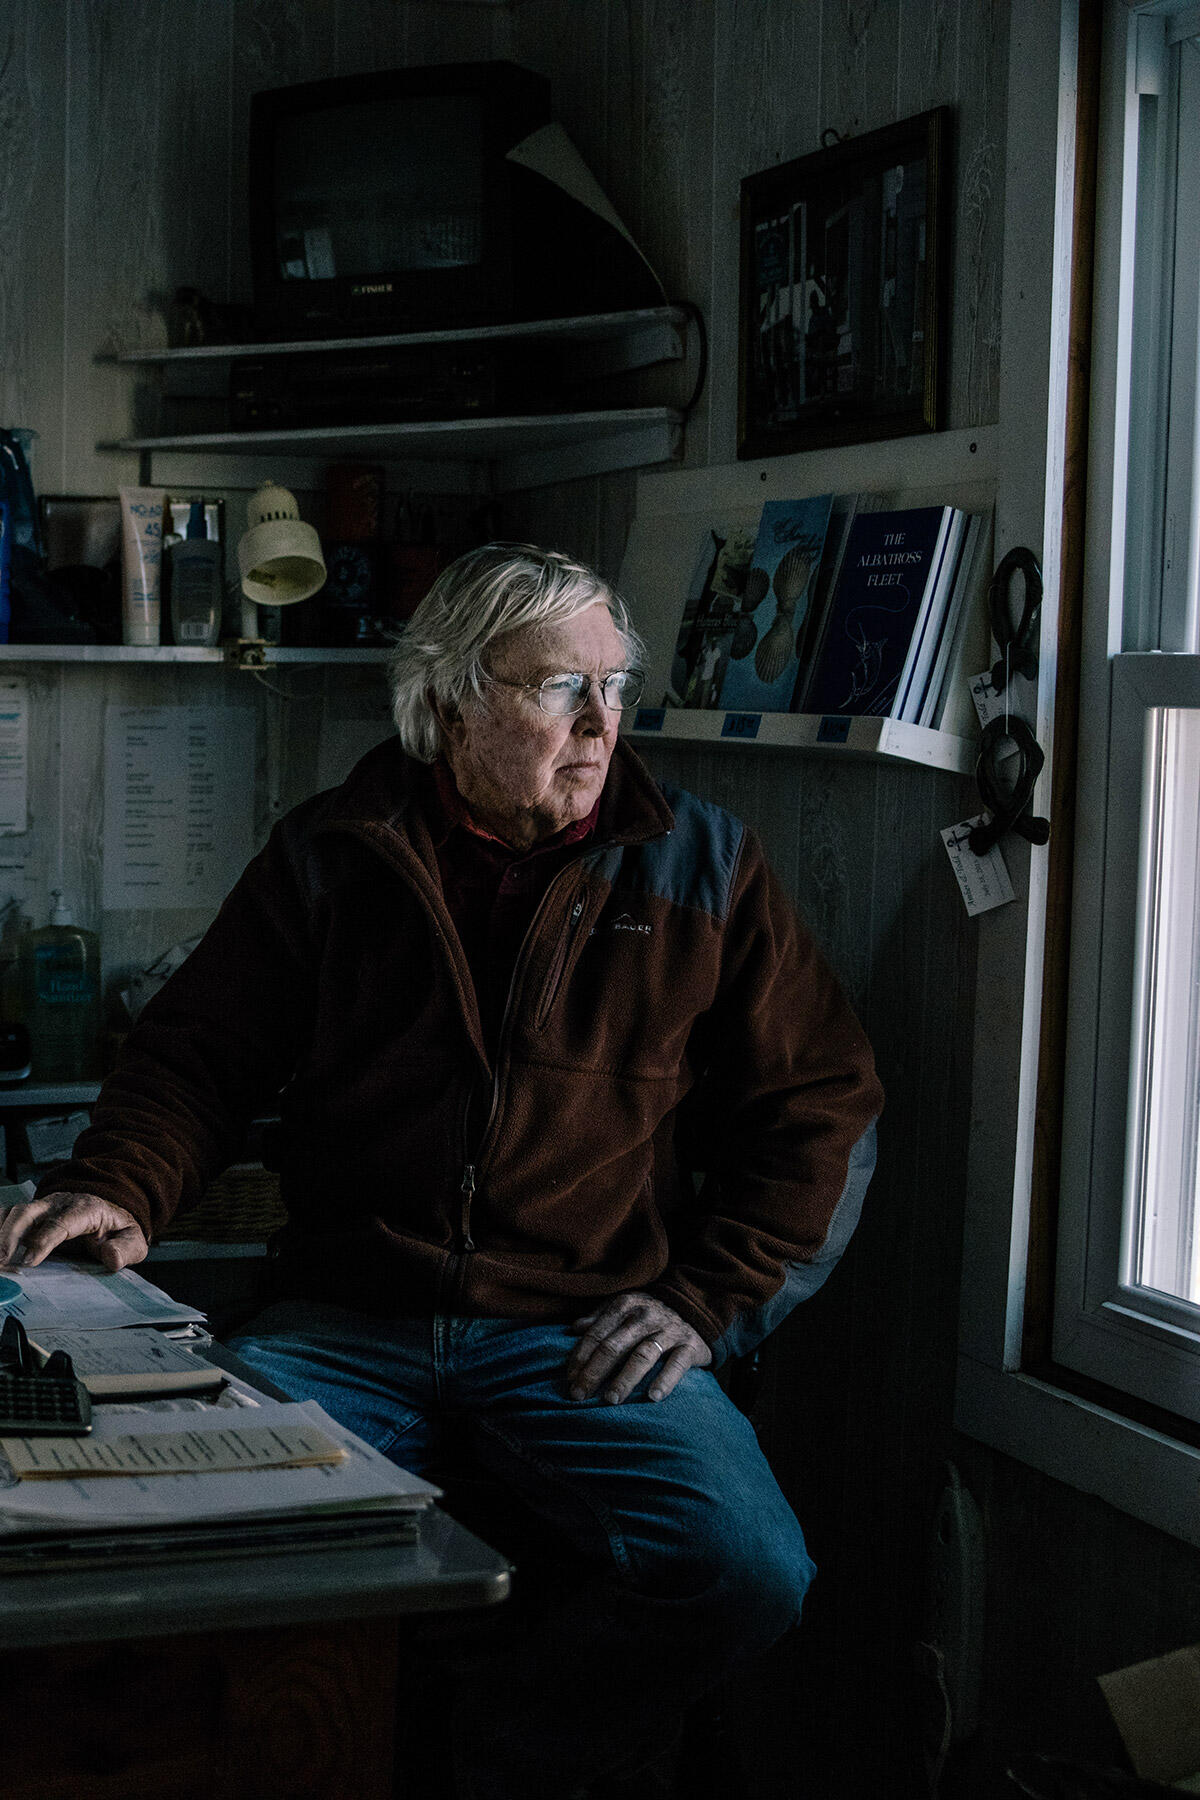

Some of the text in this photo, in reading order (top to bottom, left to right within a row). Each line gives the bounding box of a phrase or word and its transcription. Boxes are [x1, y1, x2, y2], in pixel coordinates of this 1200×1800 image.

[361, 283, 393, 294] FISHER
[883, 532, 906, 546] THE
[857, 550, 924, 567] ALBATROSS
[867, 573, 904, 587] FLEET
[614, 923, 652, 933] BAUER
